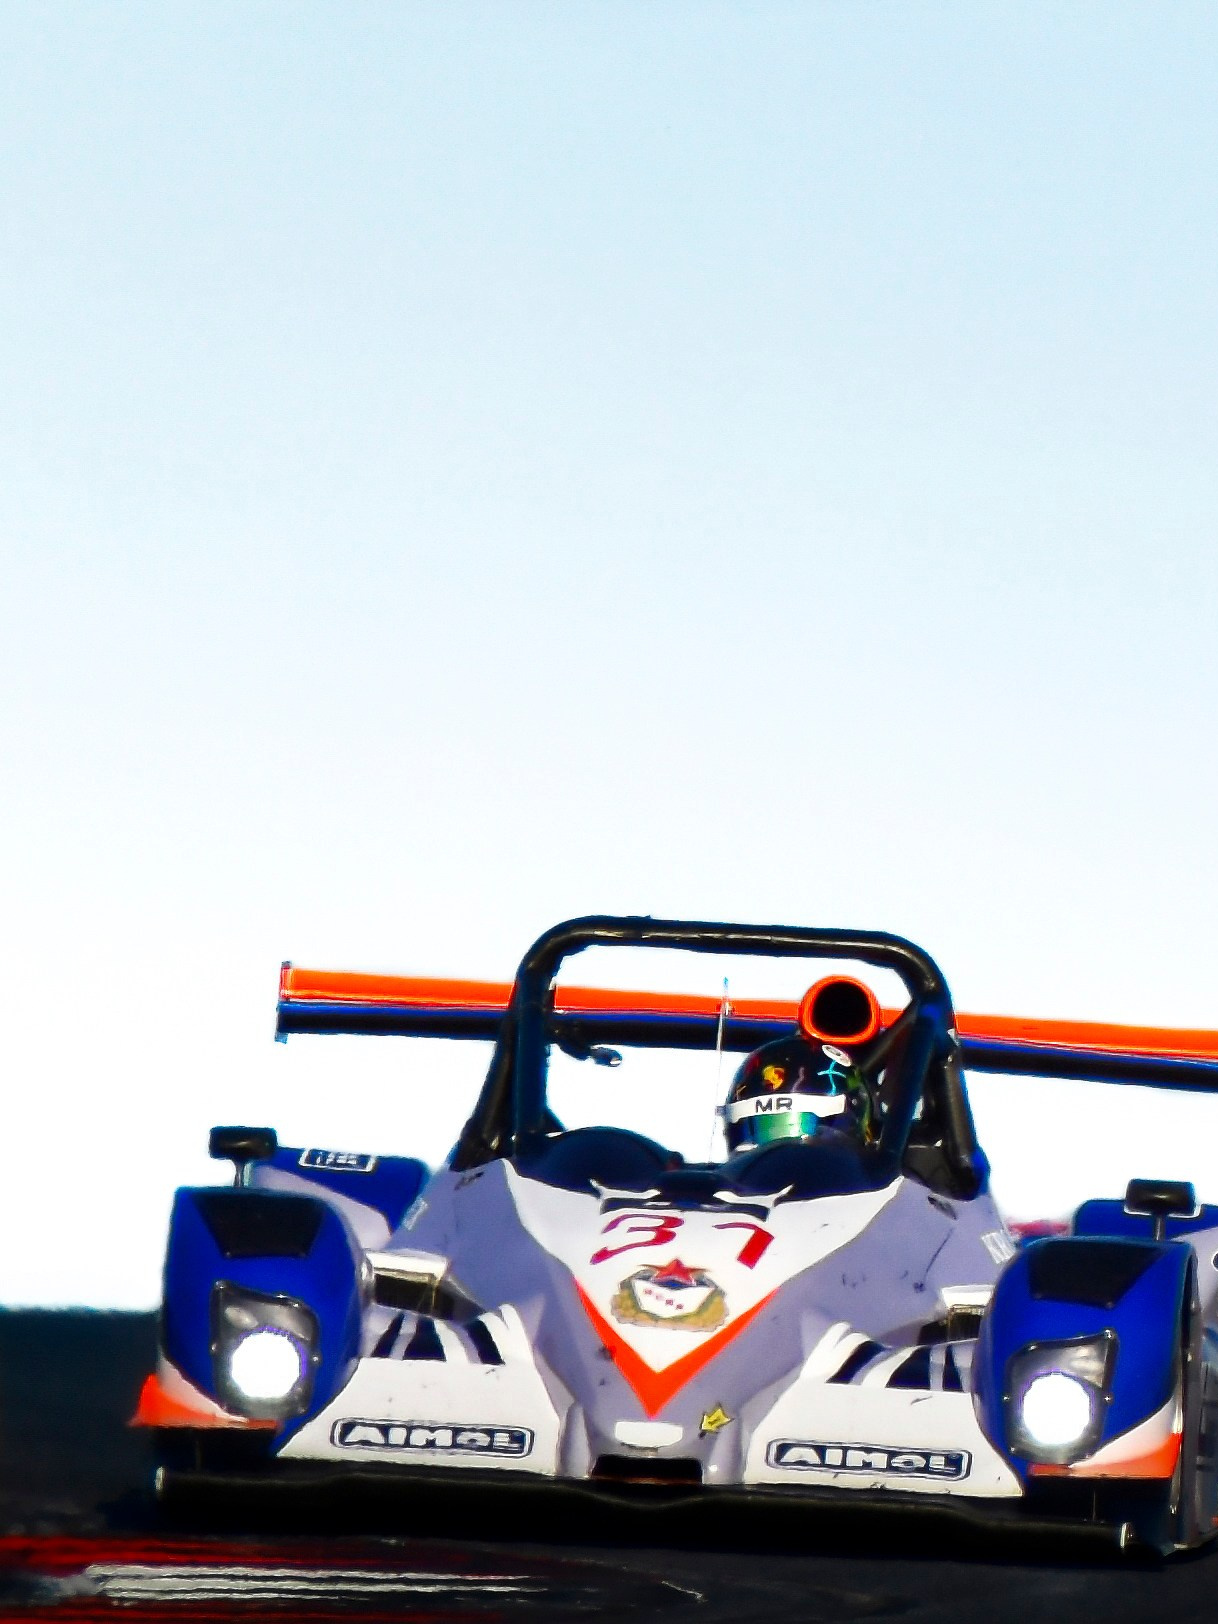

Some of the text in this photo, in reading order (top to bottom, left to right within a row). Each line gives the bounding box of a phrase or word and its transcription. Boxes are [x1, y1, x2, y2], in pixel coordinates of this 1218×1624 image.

[755, 1097, 793, 1113] MR
[344, 1425, 522, 1450] AIMOL
[779, 1446, 957, 1472] AIMOL
